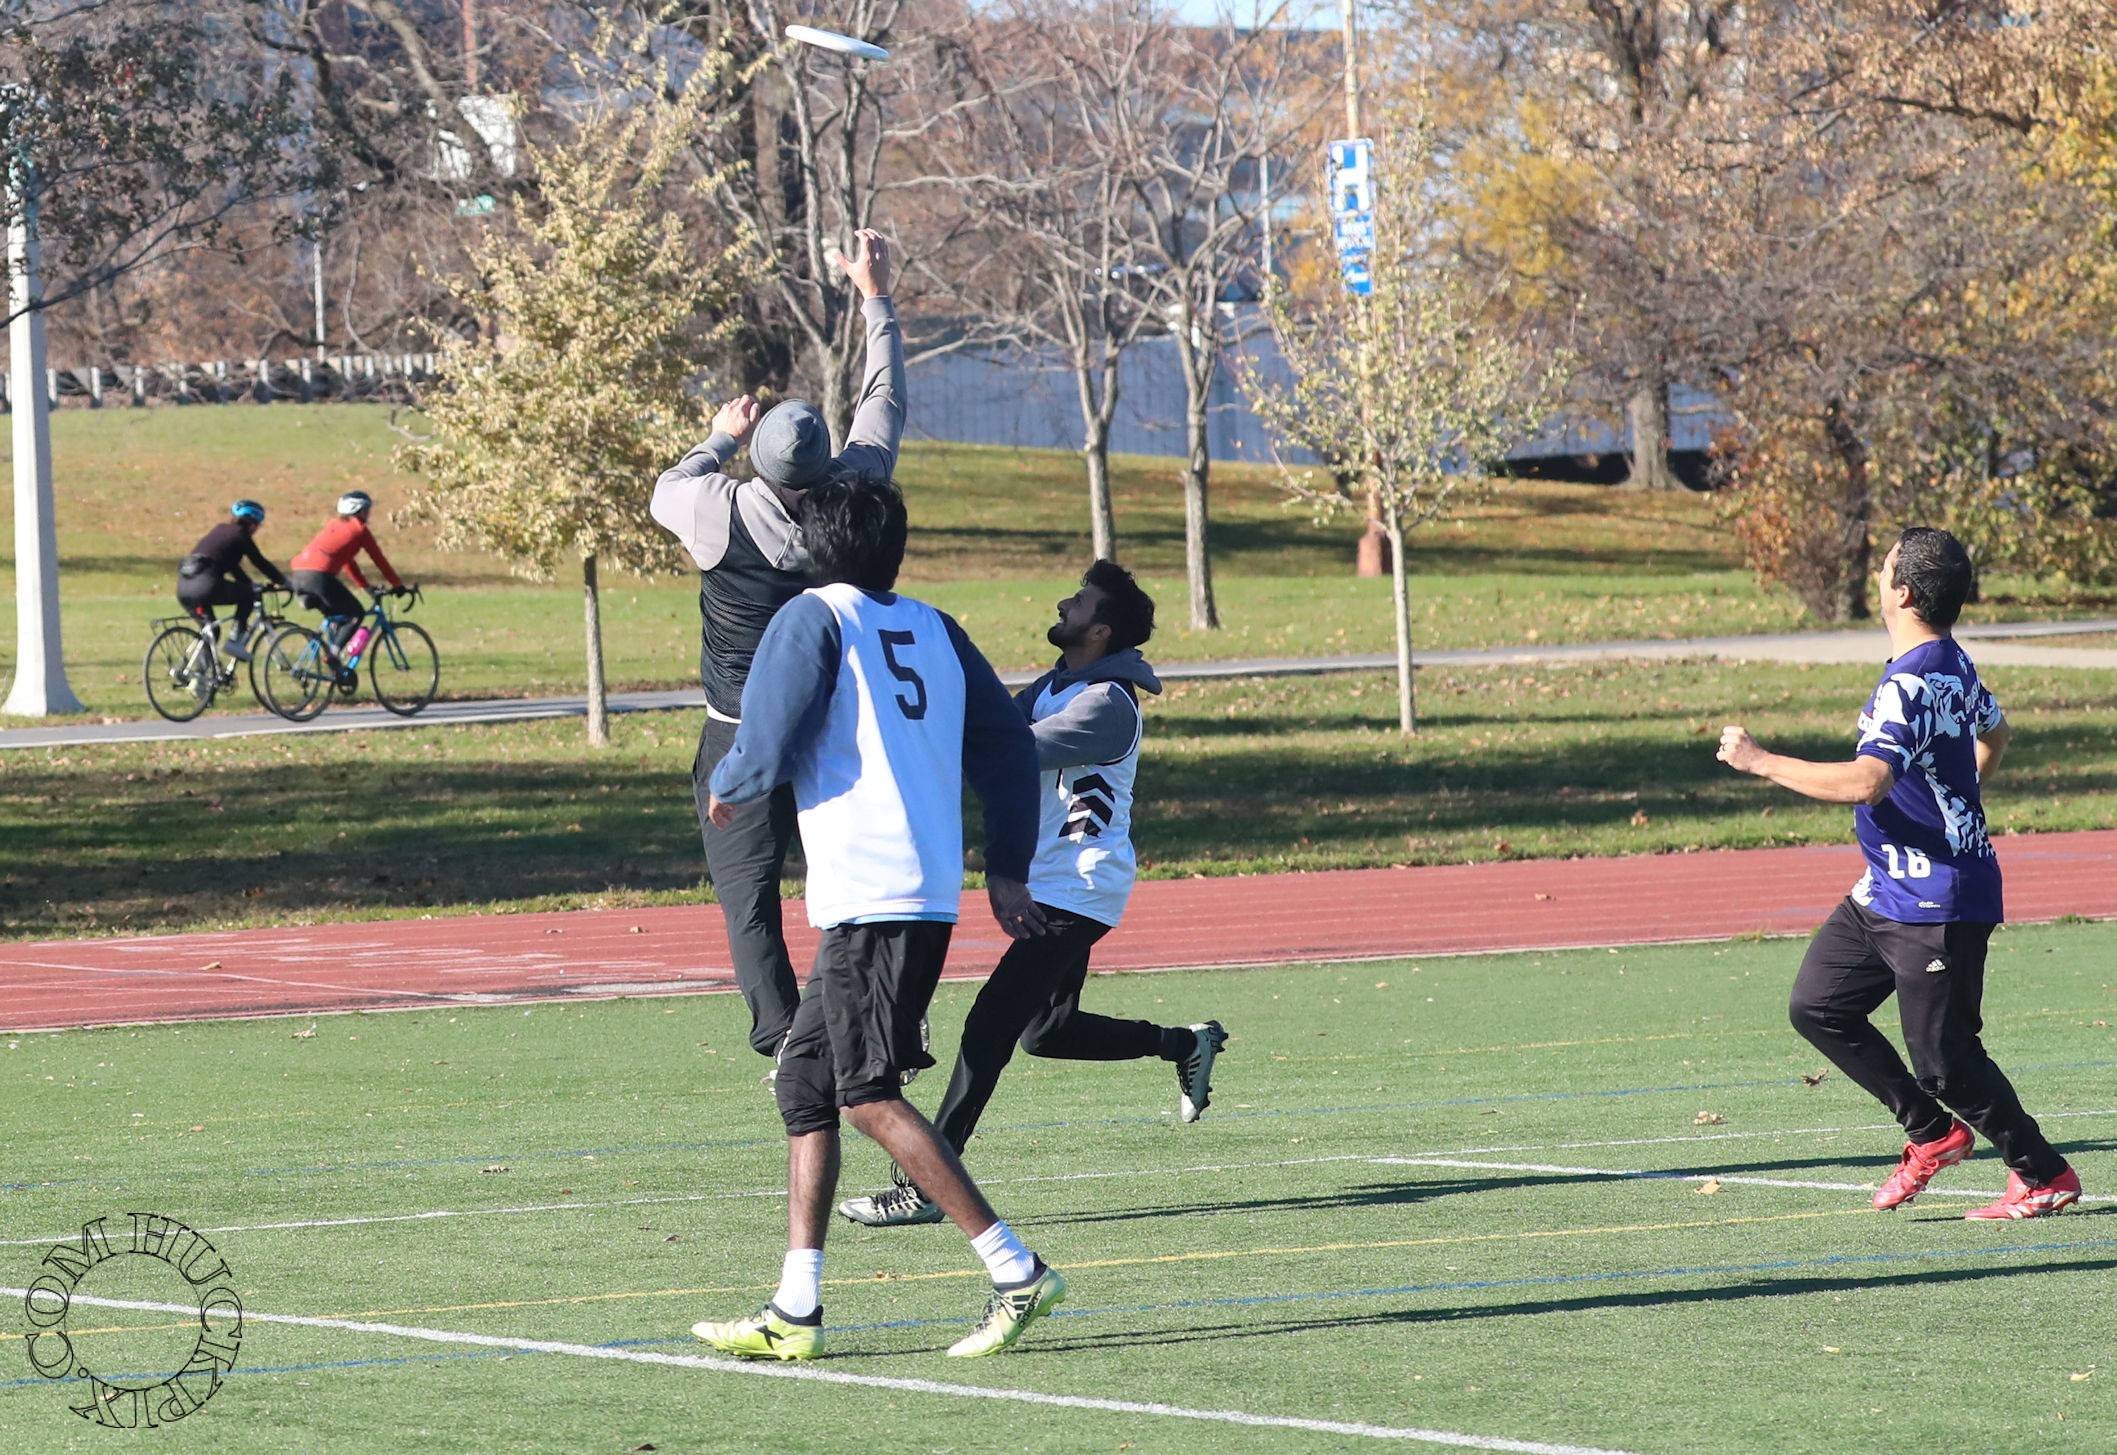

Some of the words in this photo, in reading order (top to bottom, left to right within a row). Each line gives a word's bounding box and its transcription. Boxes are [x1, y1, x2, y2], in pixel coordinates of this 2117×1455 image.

[1332, 145, 1369, 211] H
[877, 629, 928, 720] 5
[1880, 843, 1932, 879] 16
[1018, 1290, 1042, 1328] adidas
